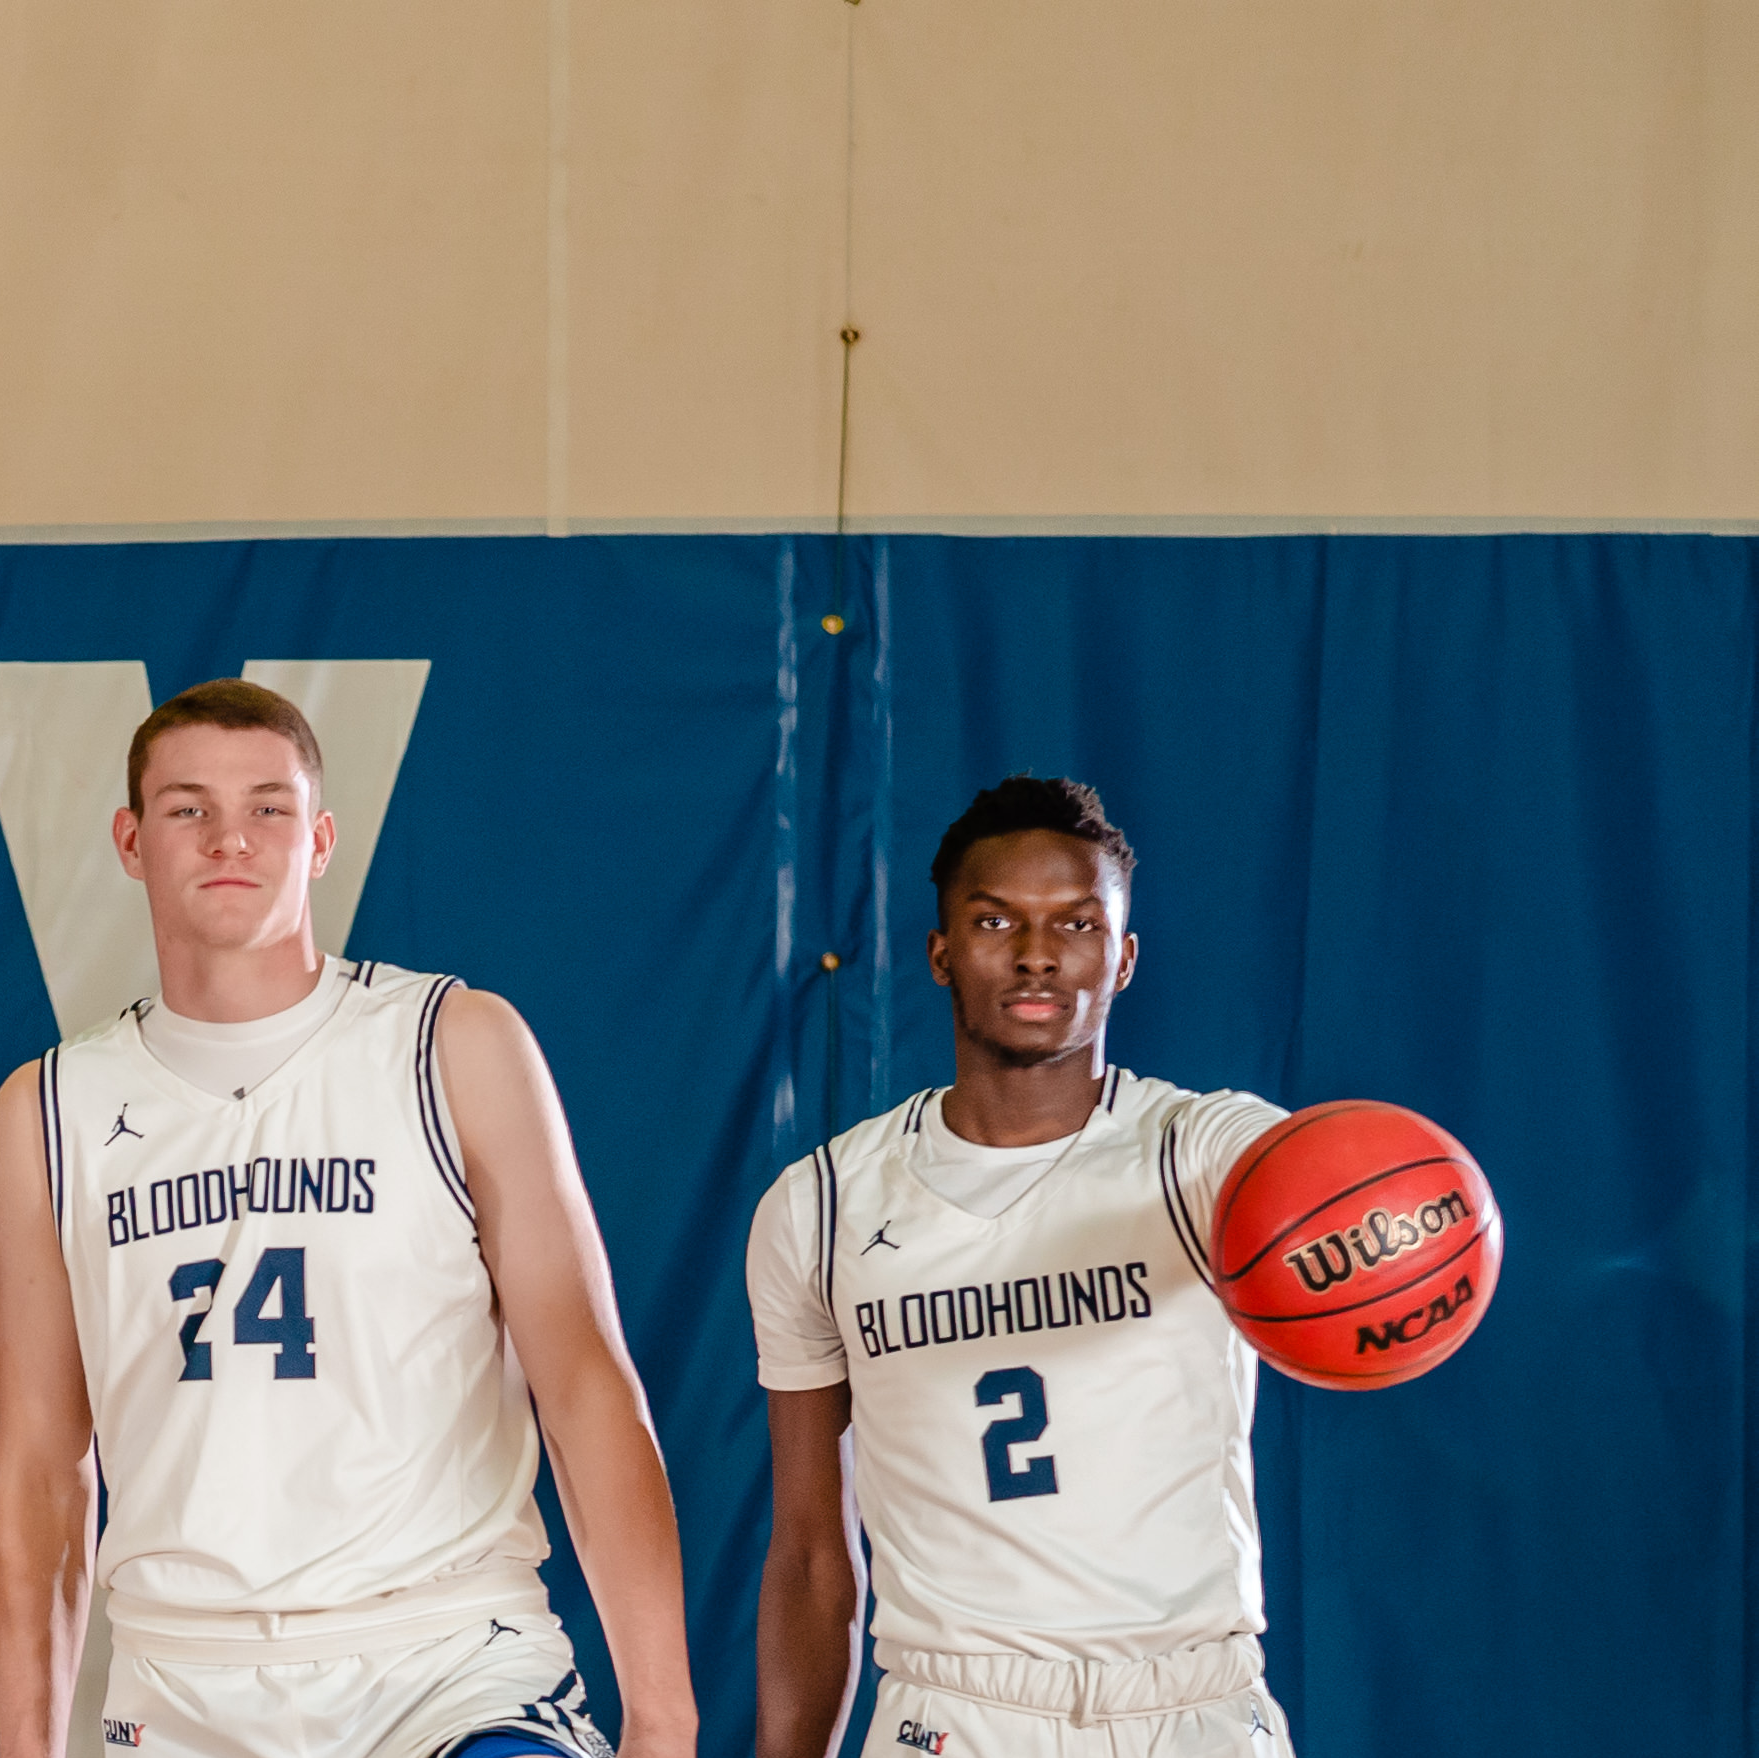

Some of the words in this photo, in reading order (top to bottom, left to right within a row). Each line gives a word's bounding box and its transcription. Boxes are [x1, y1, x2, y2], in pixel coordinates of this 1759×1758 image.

[107, 1156, 376, 1248] BLOODHOUNDS
[1283, 1188, 1472, 1296] Wilson
[168, 1246, 316, 1382] 24
[855, 1261, 1152, 1358] BLOODHOUNDS
[1355, 1274, 1474, 1354] NCAA
[973, 1365, 1059, 1502] 2
